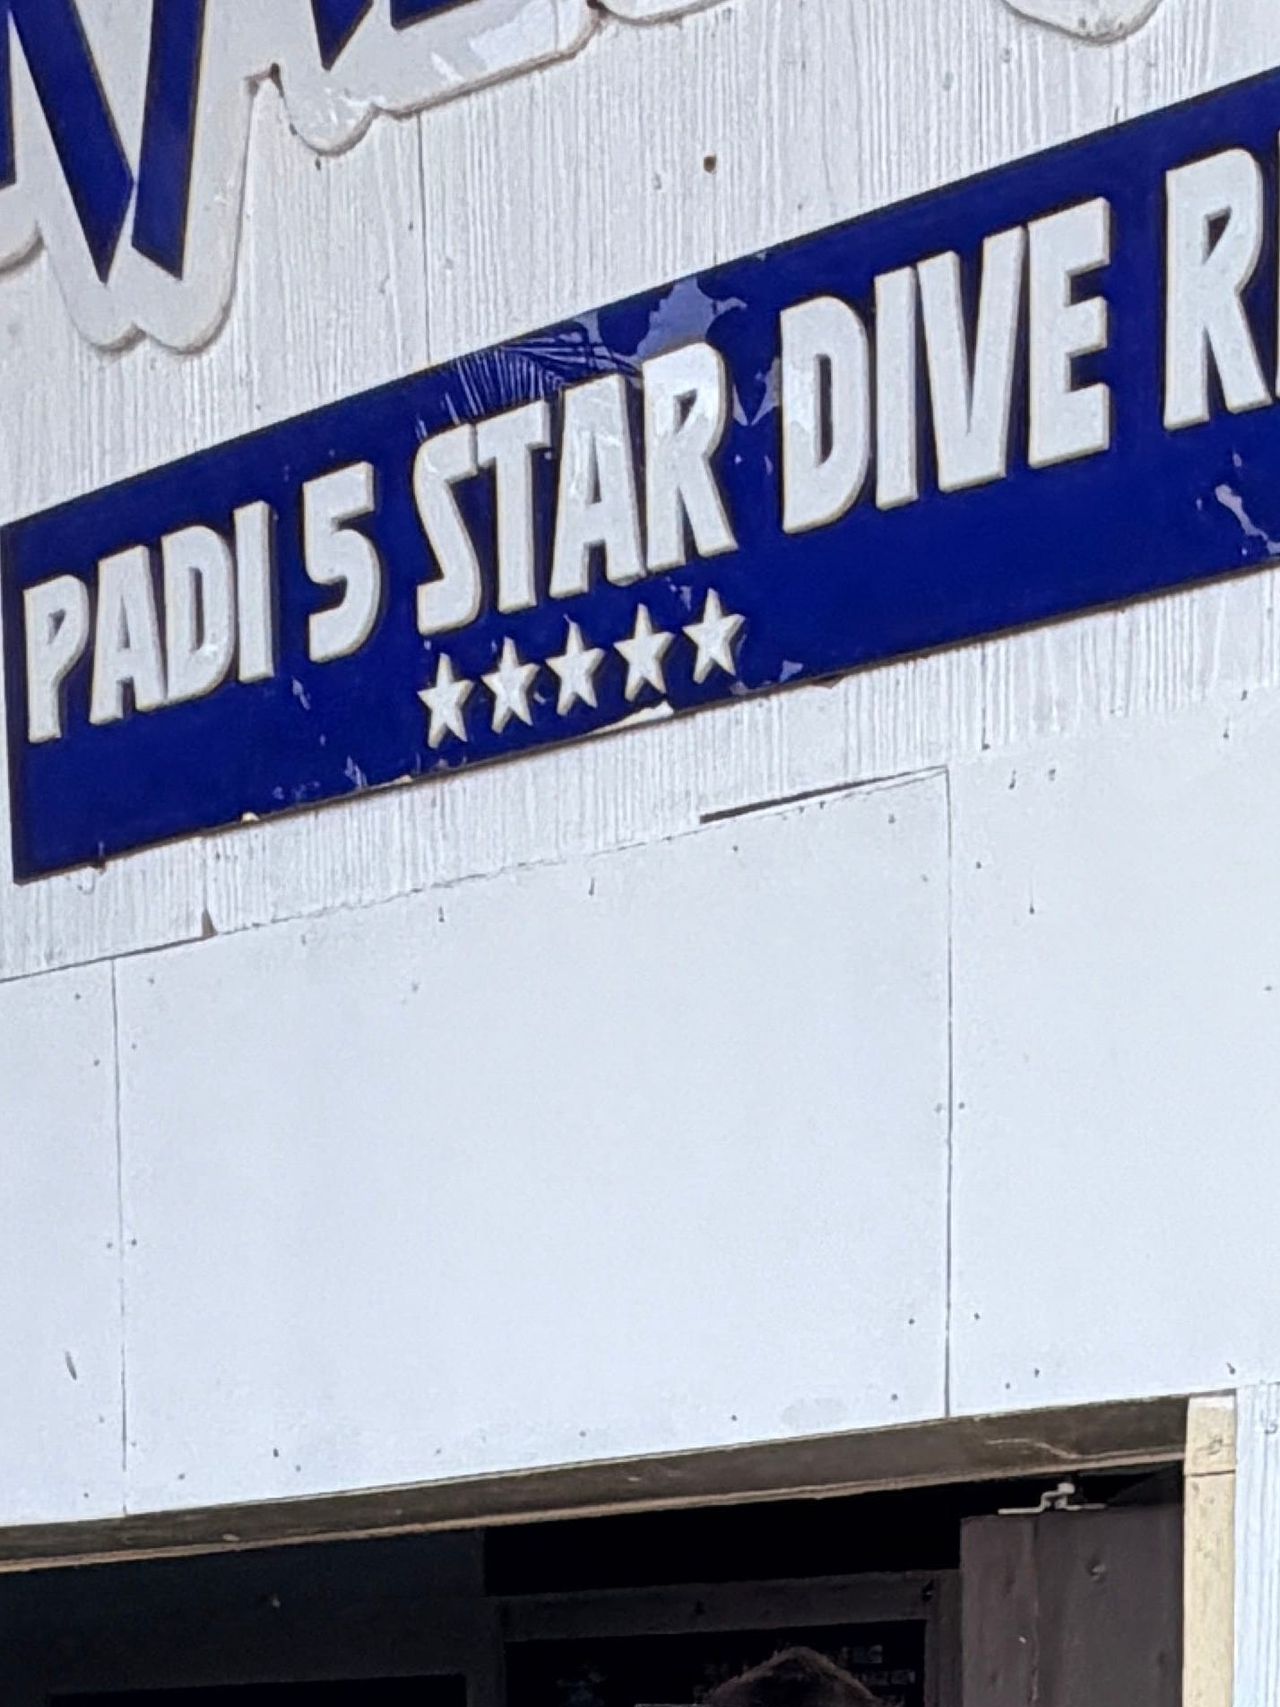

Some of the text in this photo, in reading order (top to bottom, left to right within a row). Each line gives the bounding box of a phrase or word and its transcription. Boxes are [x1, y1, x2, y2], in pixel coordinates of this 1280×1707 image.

[23, 501, 276, 746] PADI
[302, 461, 383, 664] 5
[412, 341, 739, 636] STAR
[780, 197, 1112, 535] DIVE
